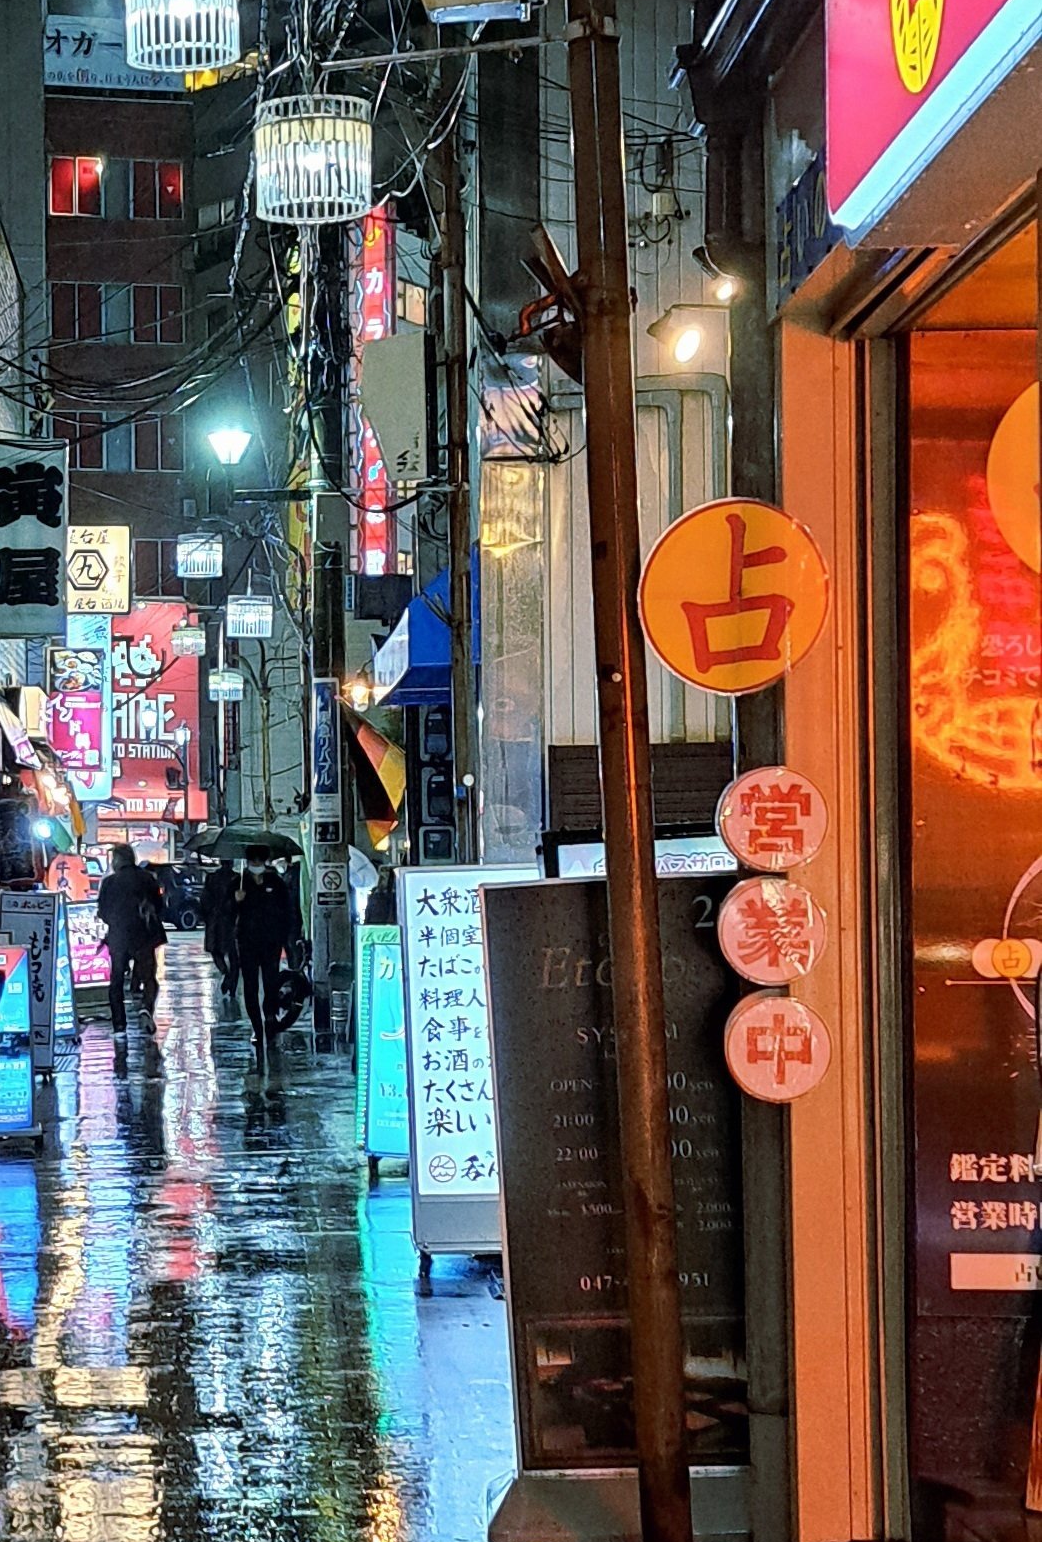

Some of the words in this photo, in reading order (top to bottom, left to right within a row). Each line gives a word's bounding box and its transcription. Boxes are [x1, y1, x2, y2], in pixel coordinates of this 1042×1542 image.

[680, 513, 795, 673] 占
[950, 1153, 1035, 1183] 鑑定料
[950, 1200, 1042, 1231] 営業時
